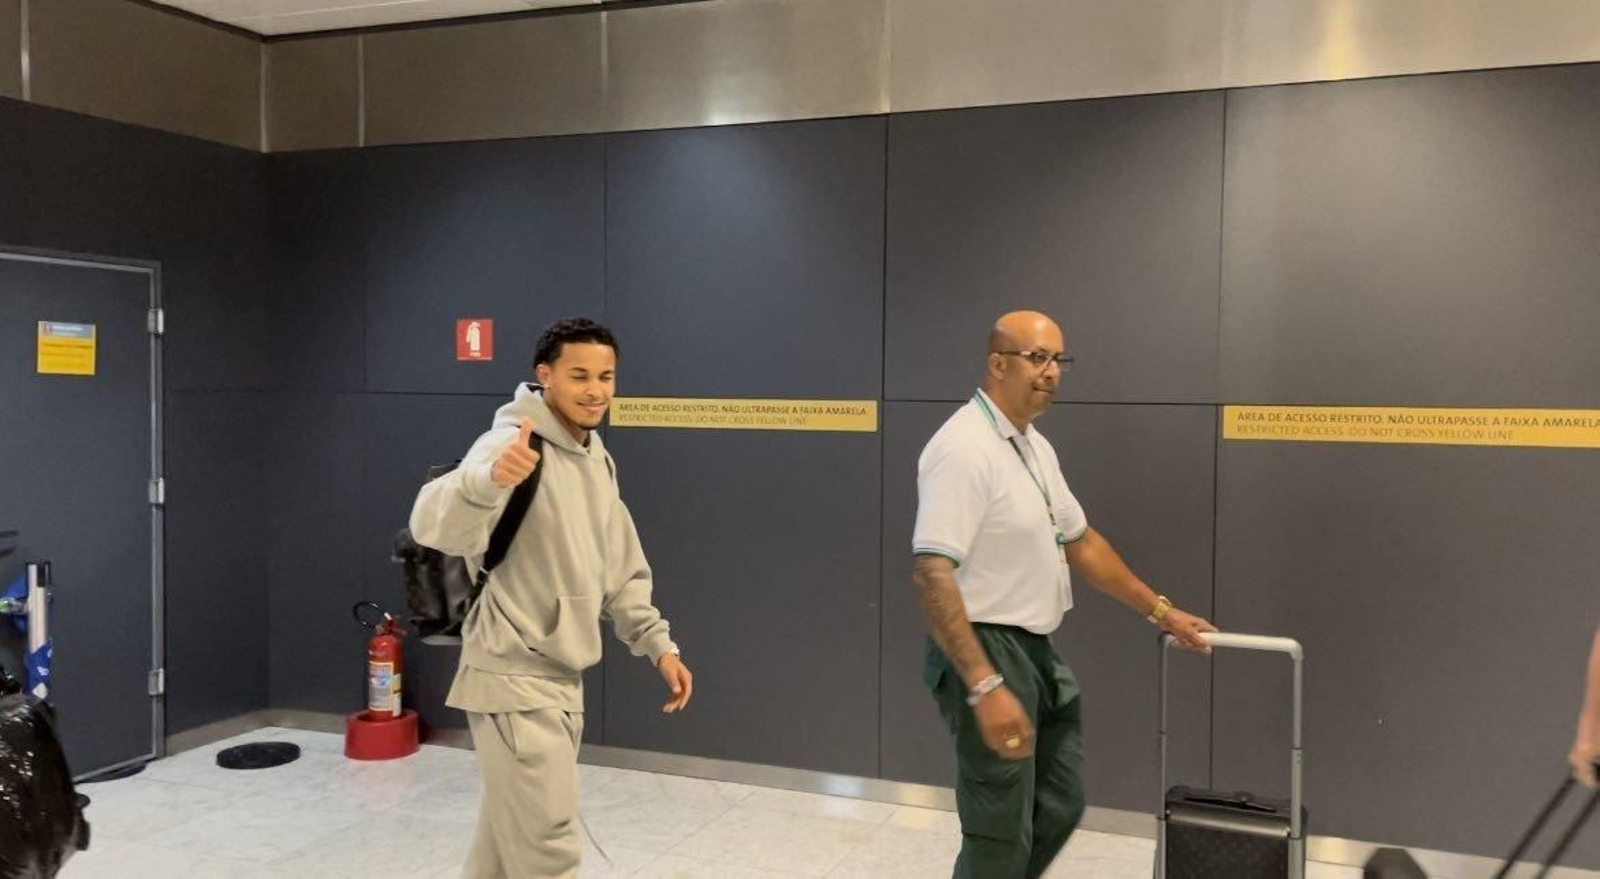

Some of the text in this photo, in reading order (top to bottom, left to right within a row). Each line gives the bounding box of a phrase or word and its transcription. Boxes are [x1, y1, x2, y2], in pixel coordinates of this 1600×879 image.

[640, 404, 650, 412] DE
[652, 404, 681, 412] ACESSO
[792, 406, 798, 414] A
[800, 406, 824, 415] FAIXA
[1268, 412, 1282, 422] DE
[1284, 413, 1328, 422] ACESSO
[1417, 415, 1488, 426] ULTRAPASSE
[1492, 416, 1500, 426] A
[1504, 416, 1539, 426] FAIXA
[1237, 424, 1300, 435] RESTRICTED
[1370, 427, 1394, 438] NOT
[1396, 428, 1434, 438] CROSS
[1438, 428, 1484, 439] YELLOW
